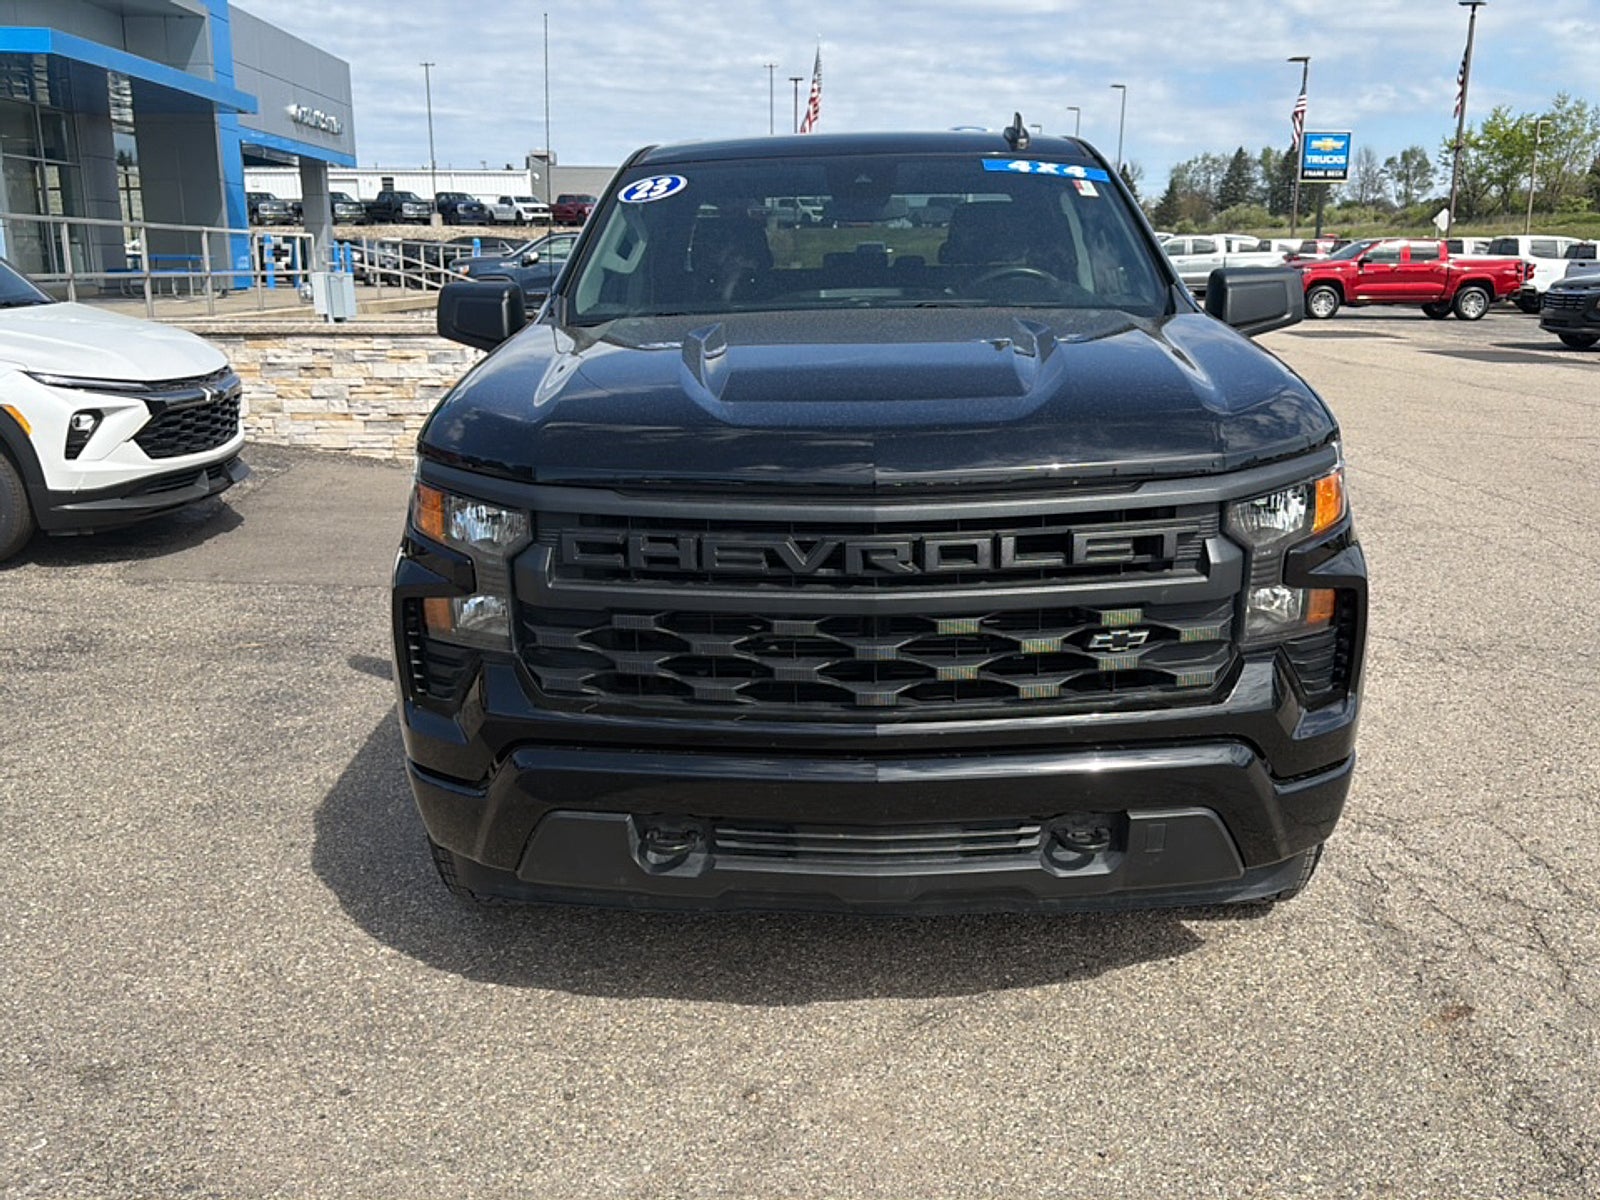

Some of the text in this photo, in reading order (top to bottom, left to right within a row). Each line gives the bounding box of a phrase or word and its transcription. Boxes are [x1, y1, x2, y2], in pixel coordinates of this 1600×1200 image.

[1306, 155, 1346, 165] TRUCKS
[630, 177, 672, 200] 23
[561, 526, 1198, 575] CHEVROLET
